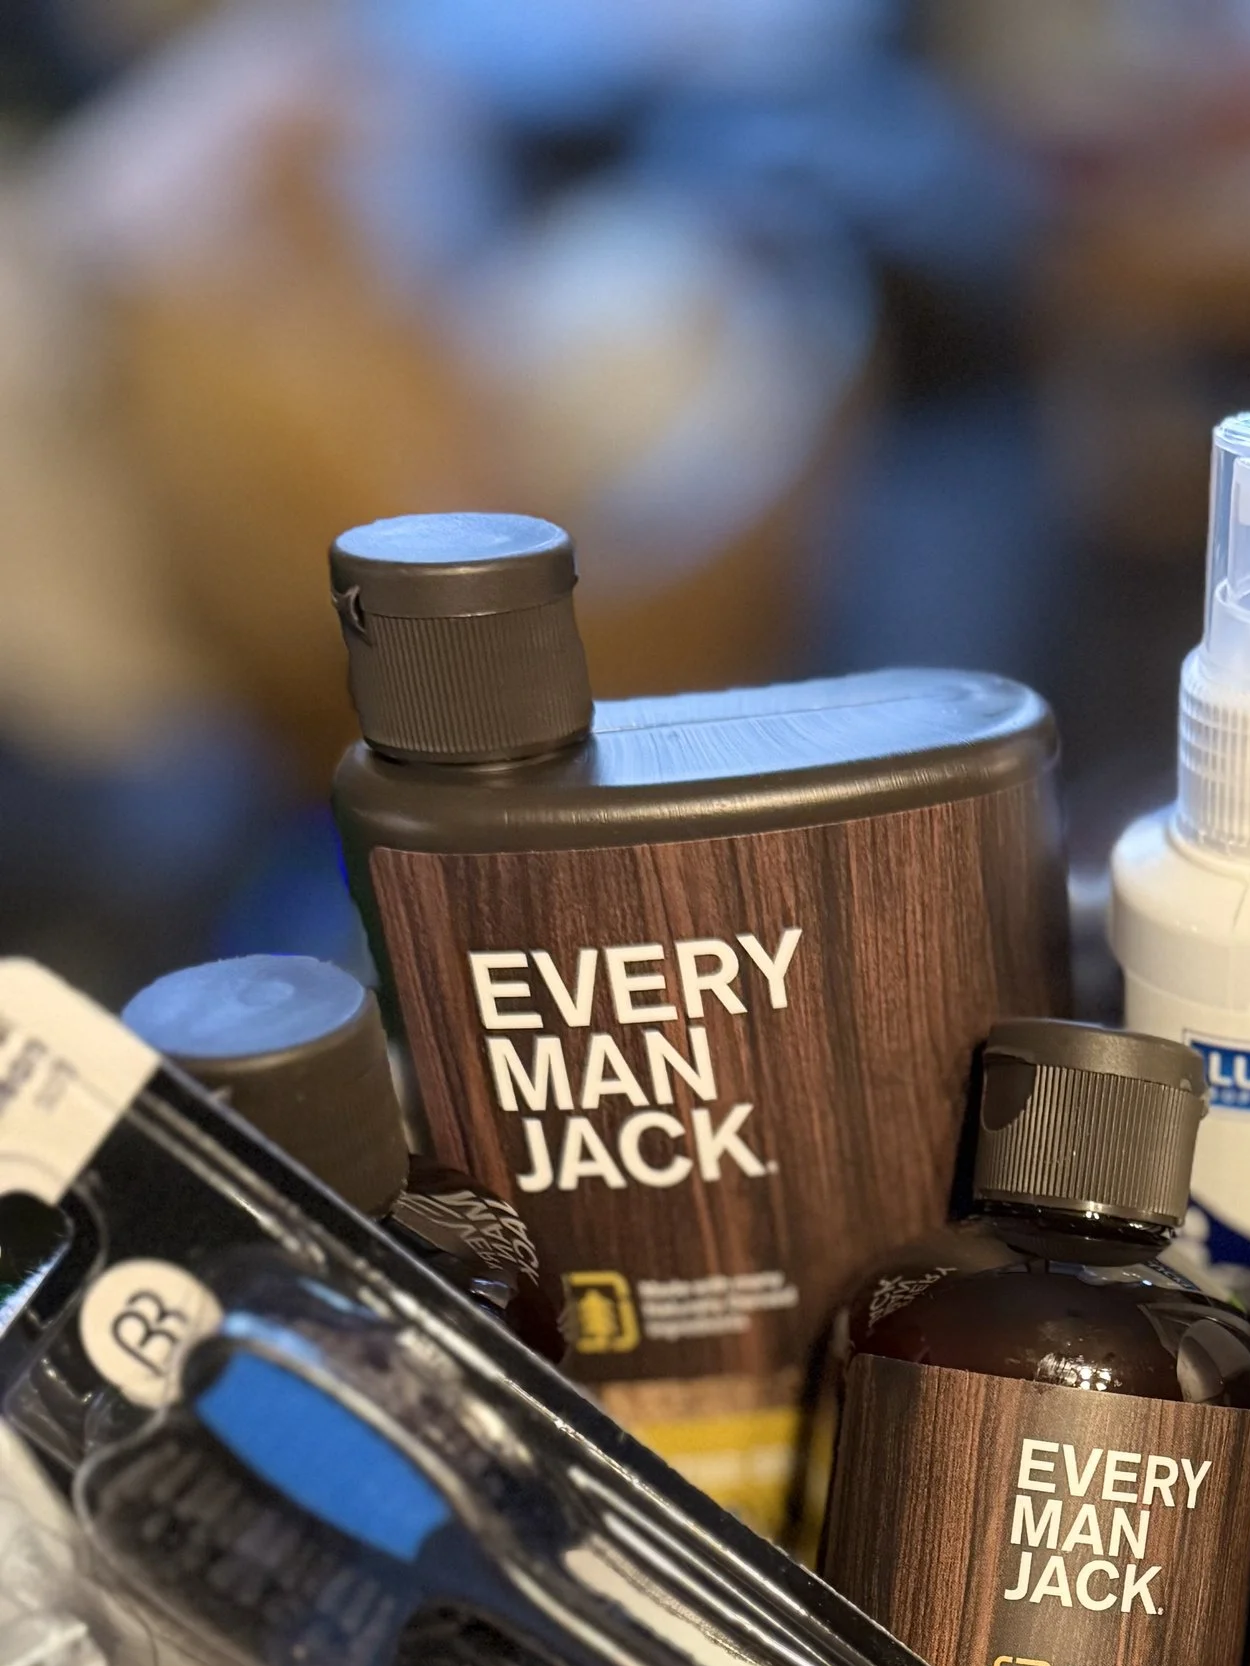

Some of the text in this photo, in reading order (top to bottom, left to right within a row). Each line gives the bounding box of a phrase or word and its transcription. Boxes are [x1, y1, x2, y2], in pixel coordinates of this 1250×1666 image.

[469, 928, 803, 1032] EVERY
[485, 1026, 720, 1113] MAN
[1017, 1437, 1212, 1511] EVERY
[1010, 1496, 1151, 1561] MAN
